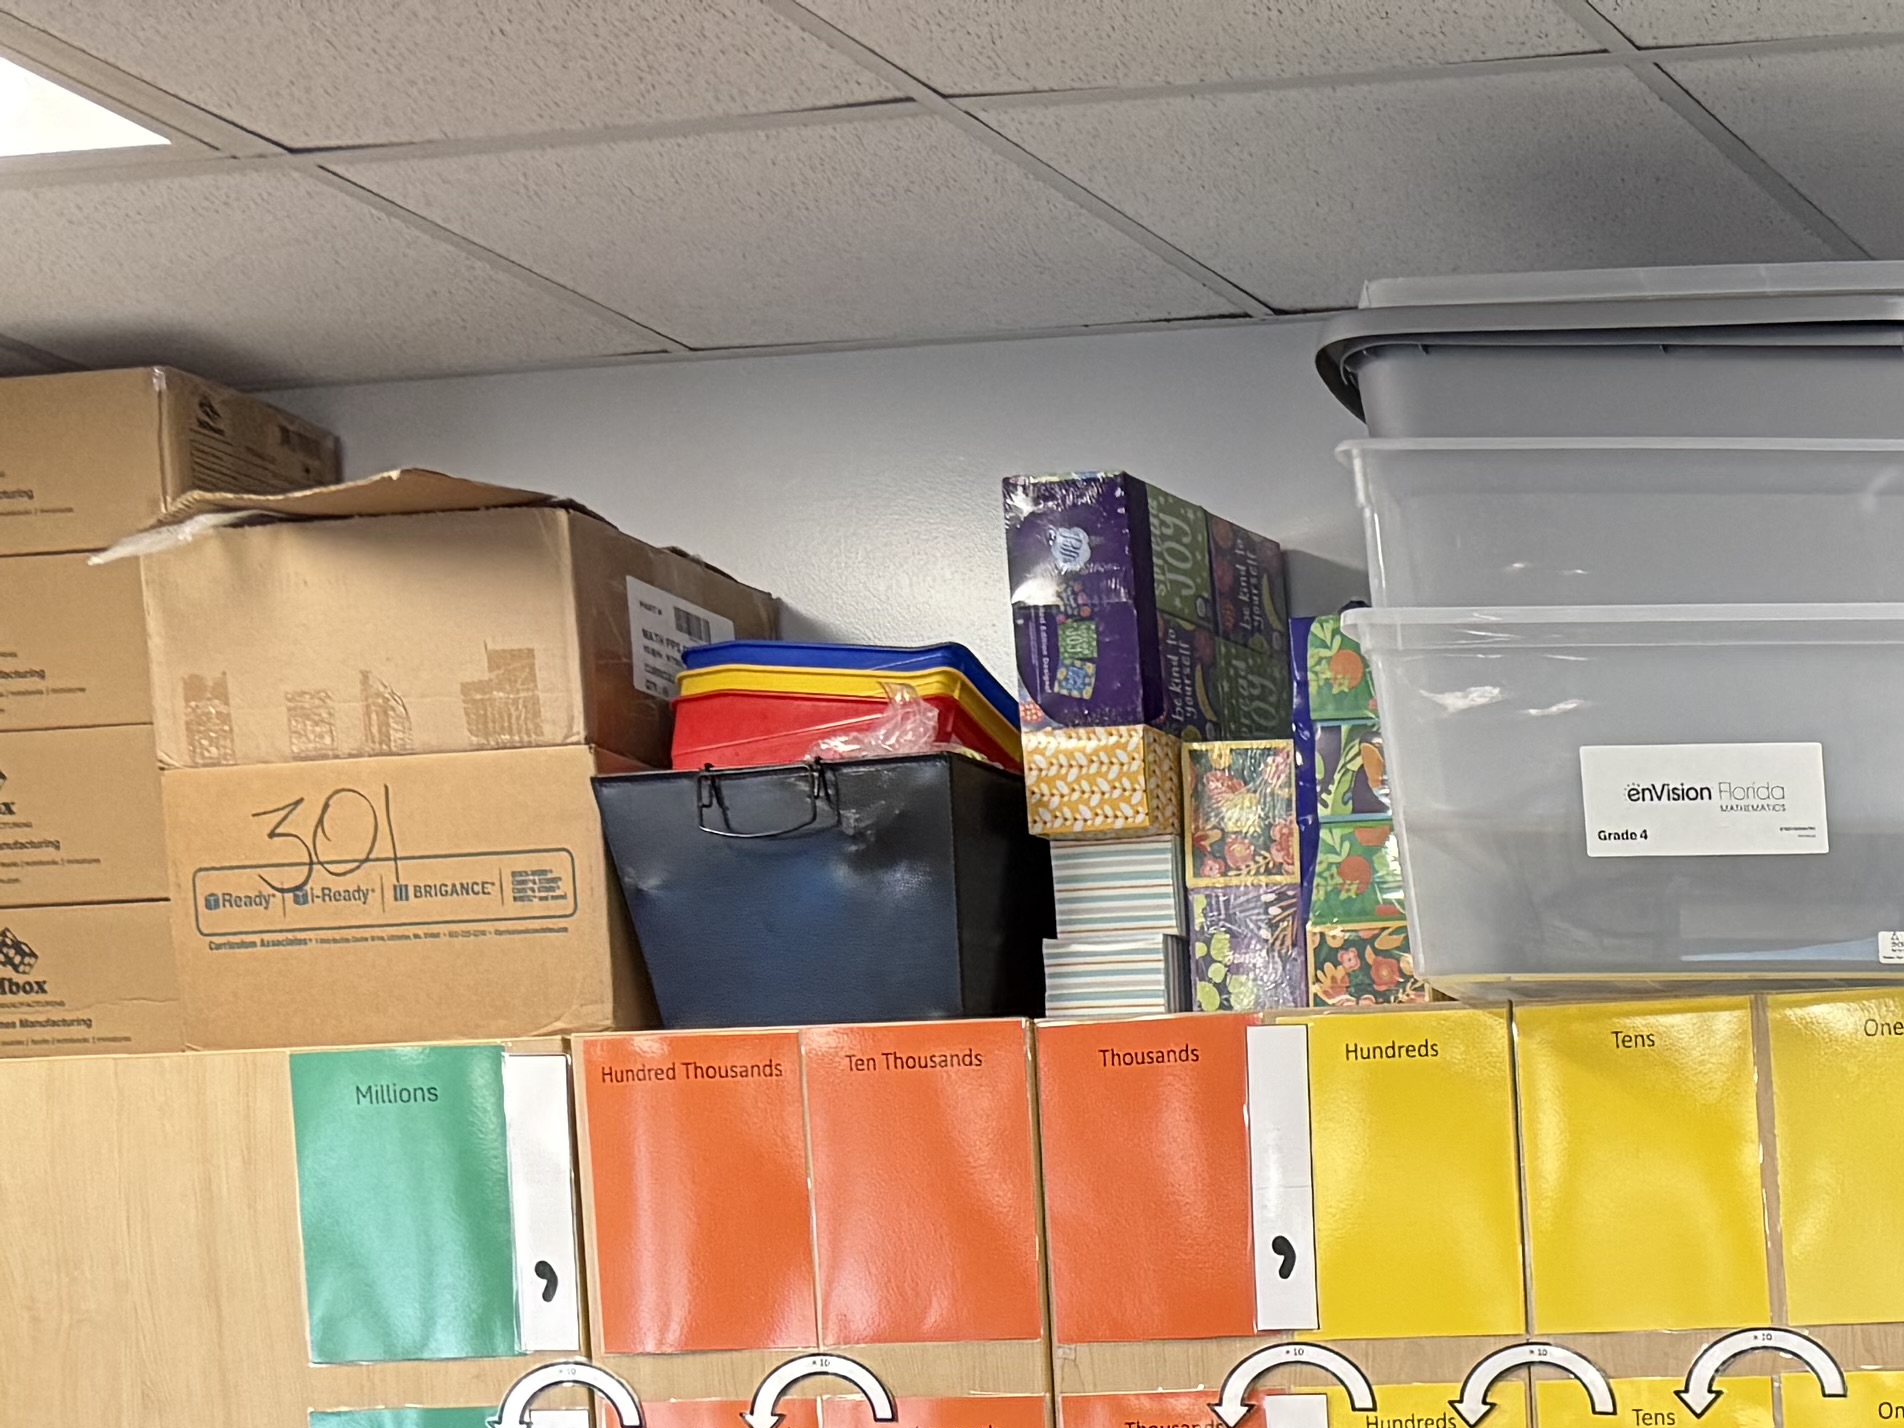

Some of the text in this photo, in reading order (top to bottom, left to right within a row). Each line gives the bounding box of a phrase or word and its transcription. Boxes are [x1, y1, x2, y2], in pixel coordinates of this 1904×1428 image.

[1166, 654, 1183, 694] kind
[1177, 640, 1198, 719] yourself
[1625, 782, 1712, 802] enVision
[251, 783, 400, 894] 301
[1597, 829, 1649, 842] Grade 4
[412, 881, 496, 899] BRIGANCE
[1344, 1036, 1440, 1062] Hundreds
[1611, 1028, 1656, 1051] Tens
[845, 1048, 984, 1073] Ten Thousands
[1098, 1043, 1201, 1068] Thousands
[600, 1058, 784, 1084] Hundred Thousands
[354, 1083, 440, 1106] Millions
[1632, 1406, 1677, 1428] Tens
